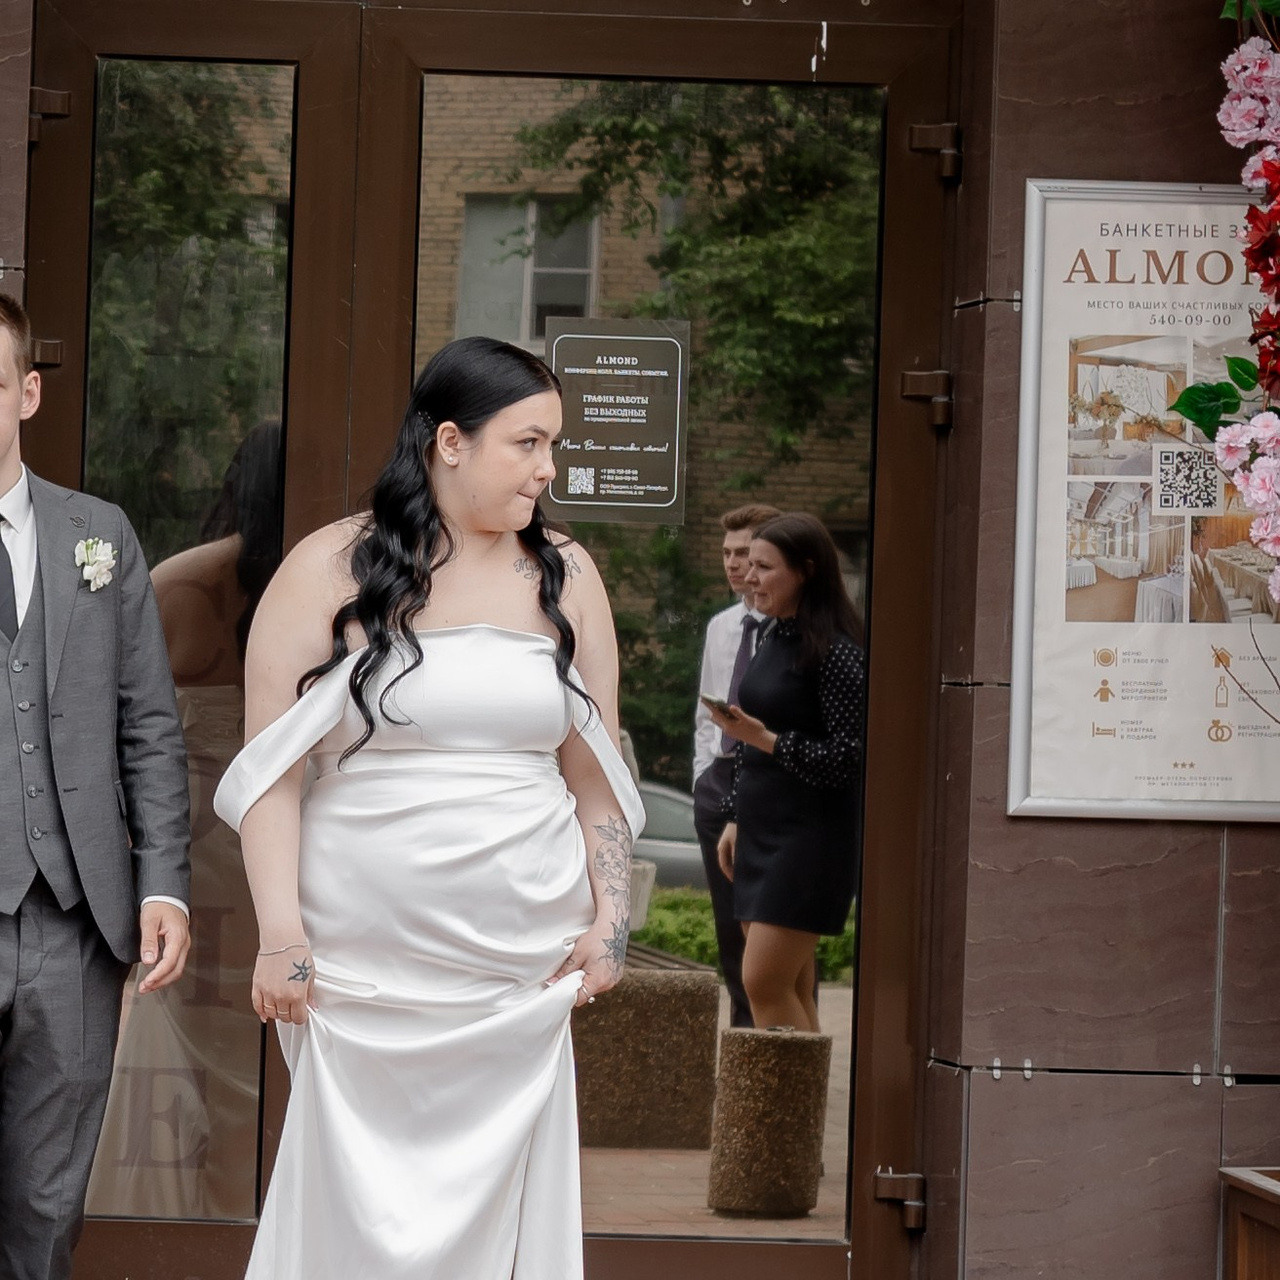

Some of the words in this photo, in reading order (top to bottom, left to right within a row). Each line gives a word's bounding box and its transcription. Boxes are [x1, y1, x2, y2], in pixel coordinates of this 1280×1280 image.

[1099, 222, 1220, 239] БАНКЕТНЫЕ
[1087, 300, 1124, 310] МЕСТО
[1128, 300, 1168, 311] ВАШИХ
[1171, 301, 1244, 311] СЧАСТЛИВЫХ
[1149, 314, 1232, 327] 540-09-00
[596, 355, 639, 366] ALMOND
[582, 394, 615, 404] ГРАФИК
[616, 395, 649, 405] РАБОТЫ
[584, 407, 599, 416] БЕЗ
[599, 408, 647, 418] ВЫХОДНЫХ
